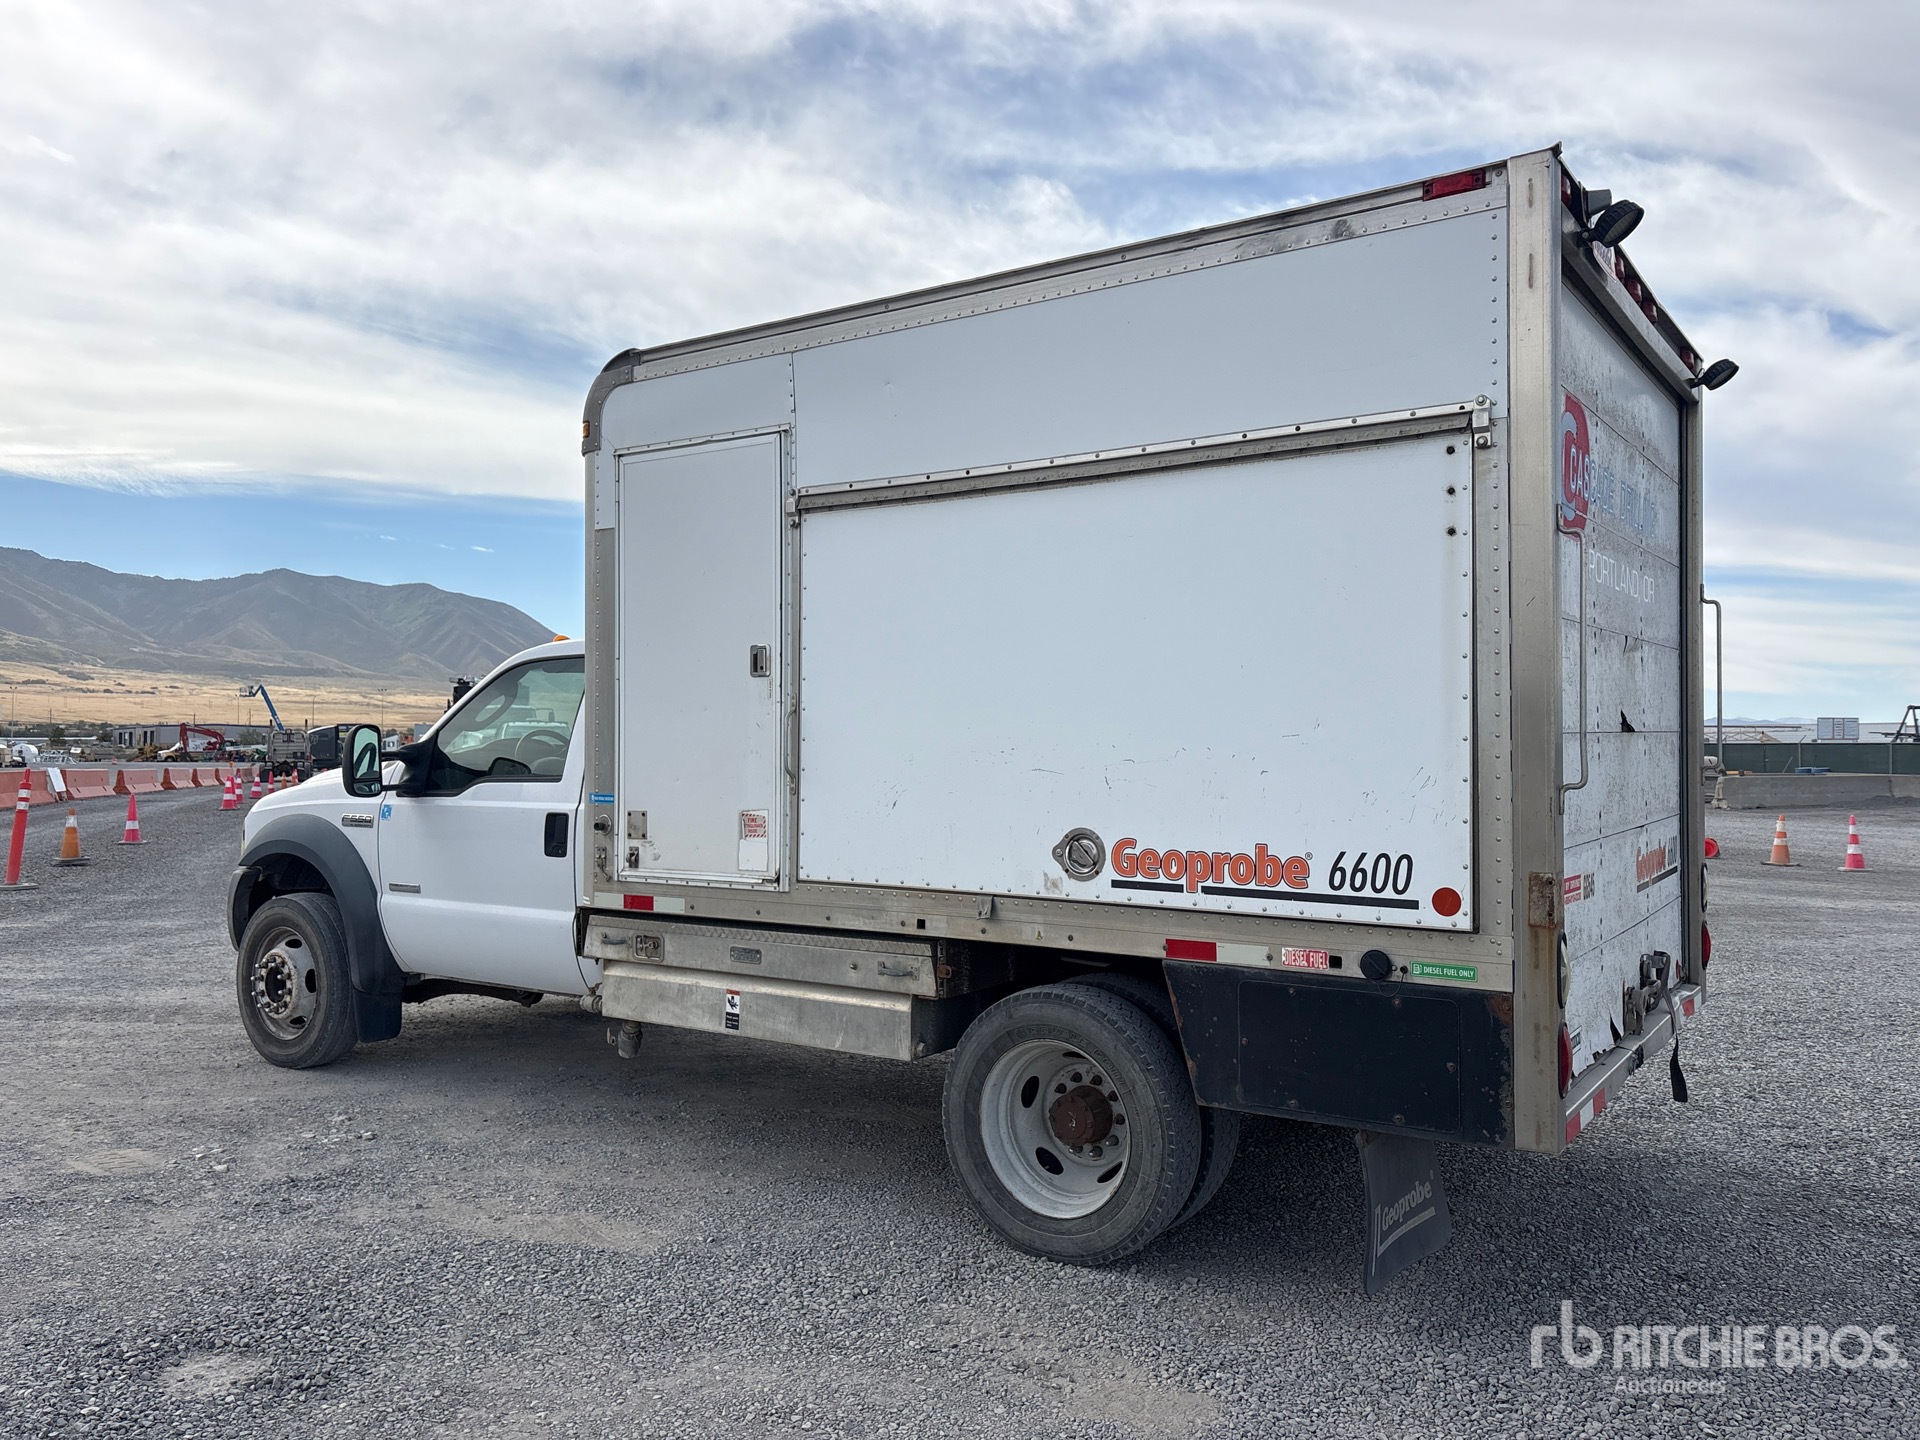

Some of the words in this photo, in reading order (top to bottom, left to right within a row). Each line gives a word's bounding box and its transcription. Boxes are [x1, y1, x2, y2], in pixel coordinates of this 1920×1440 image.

[1328, 851, 1414, 895] 6600
[1283, 949, 1308, 967] DIESEL
[1309, 951, 1327, 969] FUEL
[1423, 966, 1443, 975] DIESEL
[1443, 968, 1458, 977] FUEL
[1458, 969, 1474, 978] ONLY
